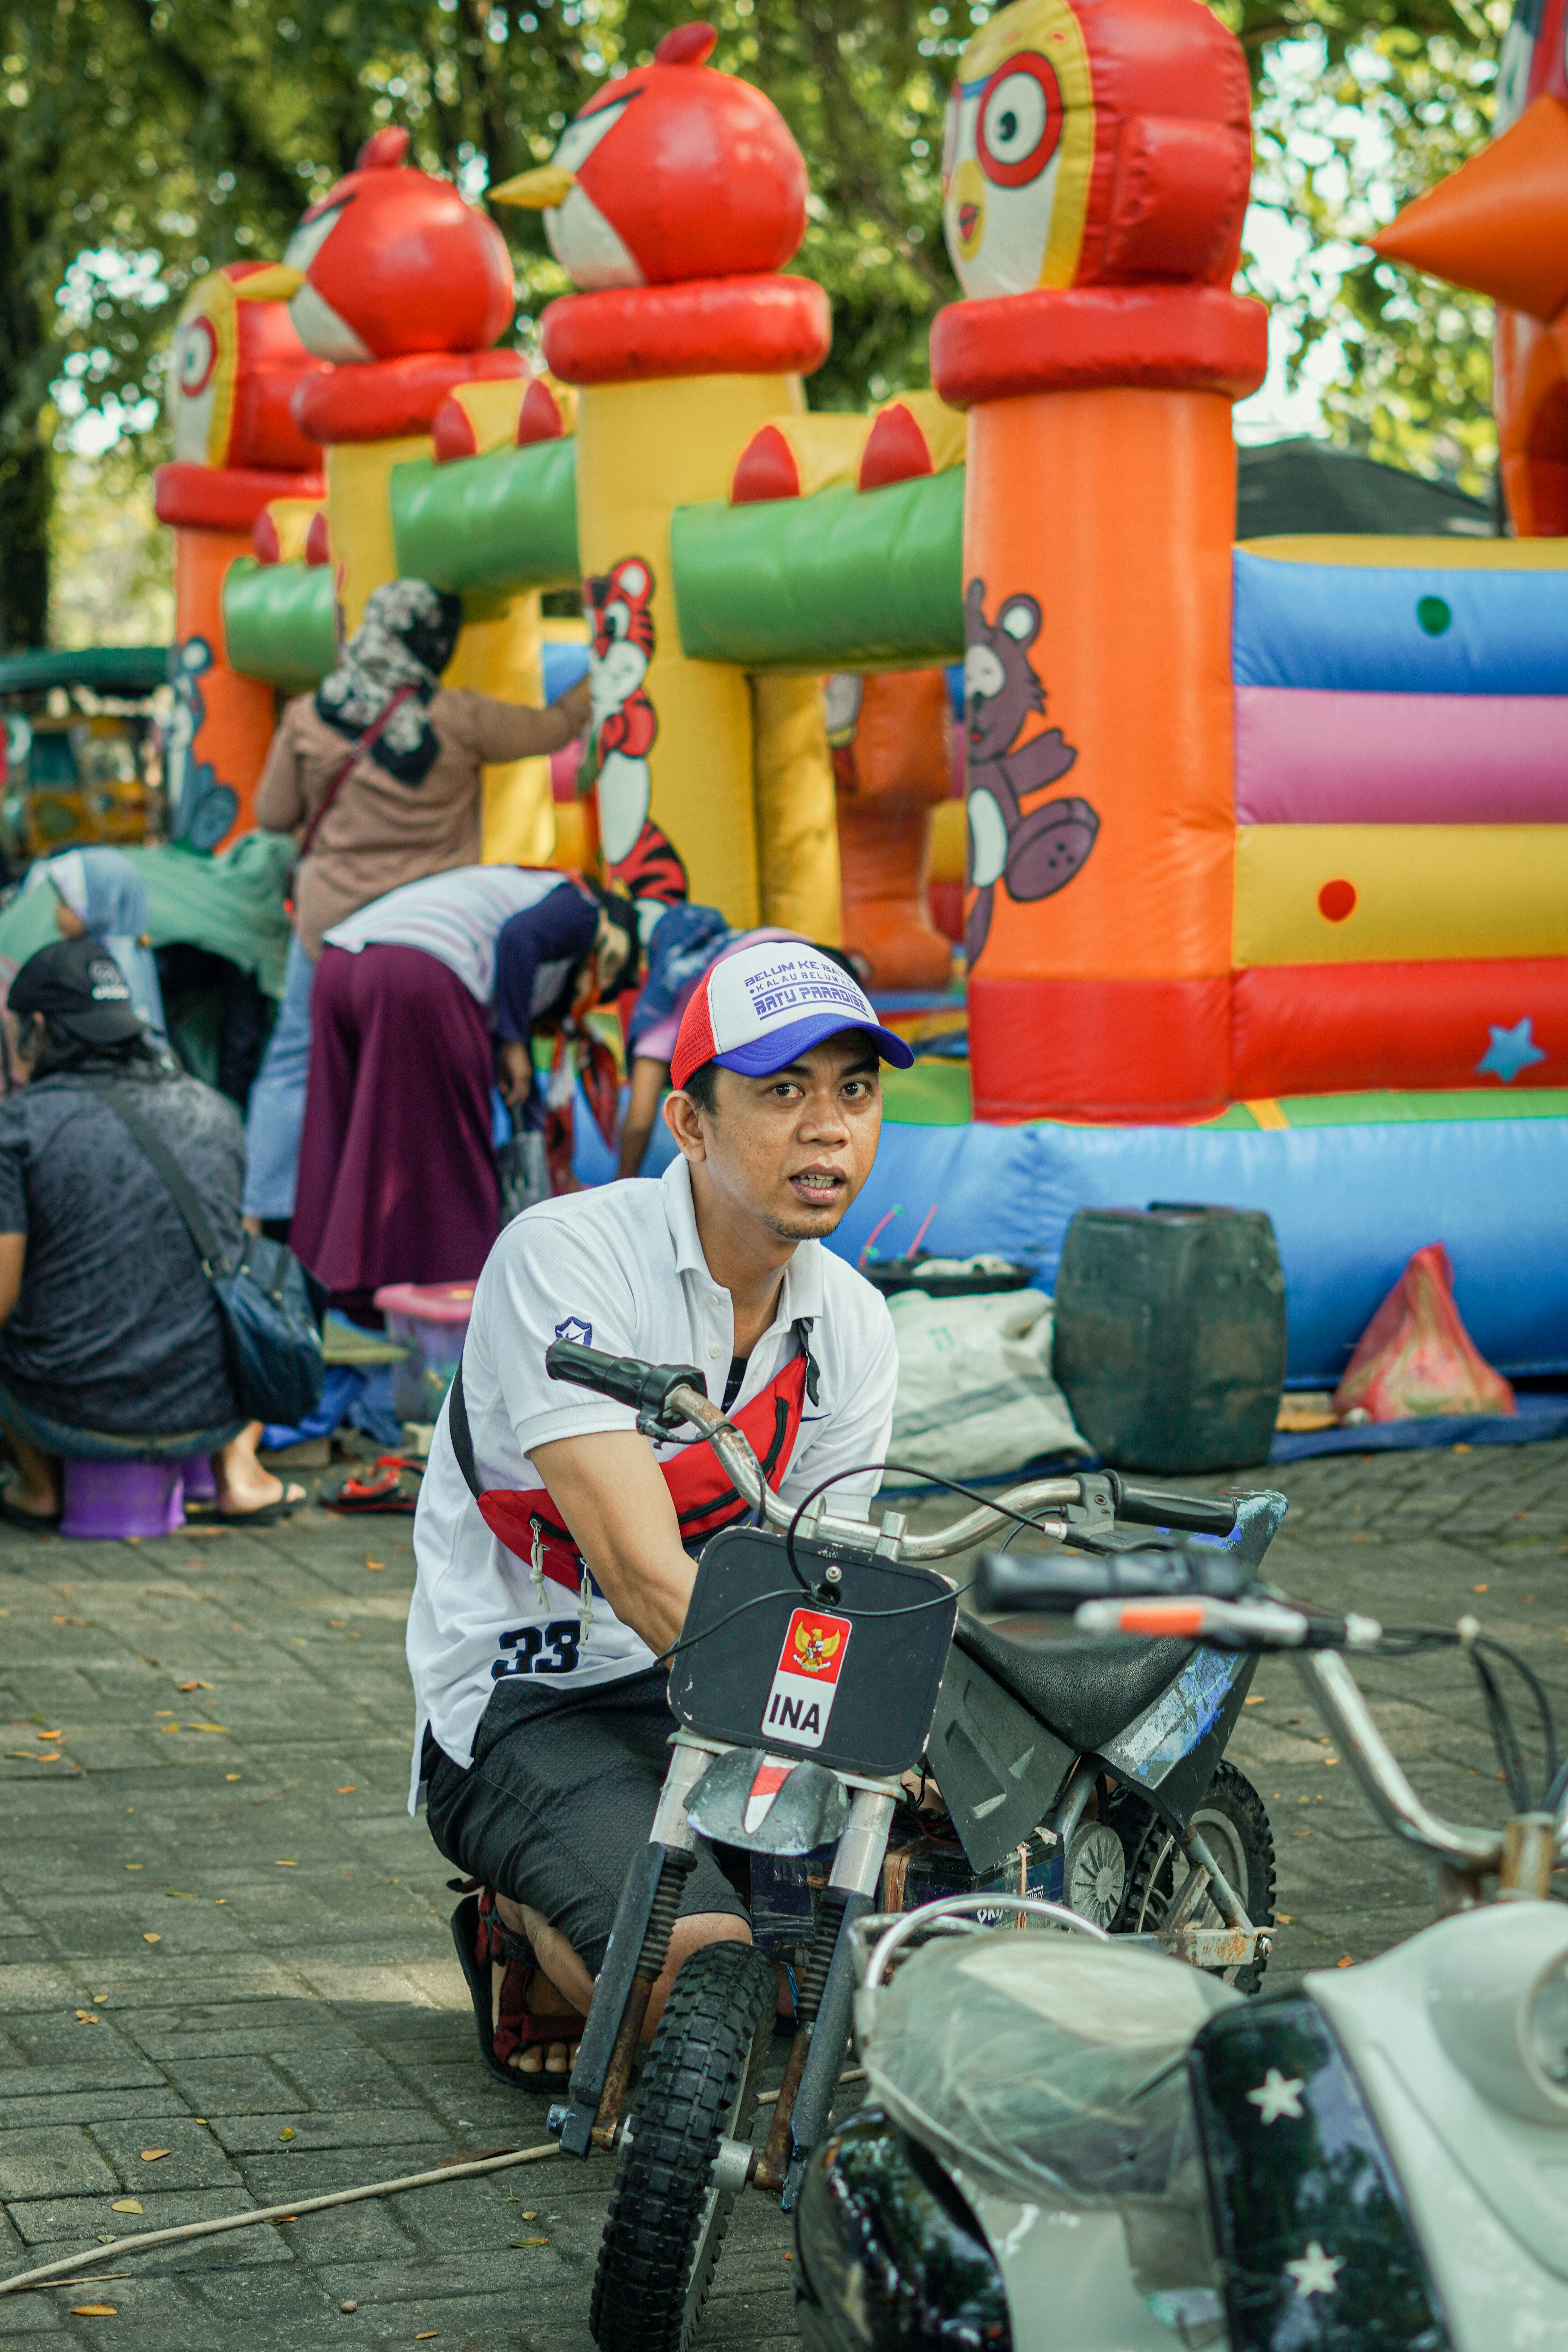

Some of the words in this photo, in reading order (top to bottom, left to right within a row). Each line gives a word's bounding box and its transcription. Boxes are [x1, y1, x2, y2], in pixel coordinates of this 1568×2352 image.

[744, 962, 795, 987] BELUM
[798, 961, 820, 969] KE
[821, 964, 853, 984] BATU
[756, 973, 797, 992] KALAU
[801, 972, 839, 983] BELUM
[754, 989, 797, 1015] BATU
[799, 986, 867, 1012] PARADISE
[491, 1620, 588, 1682] 33
[769, 1693, 819, 1735] INA
